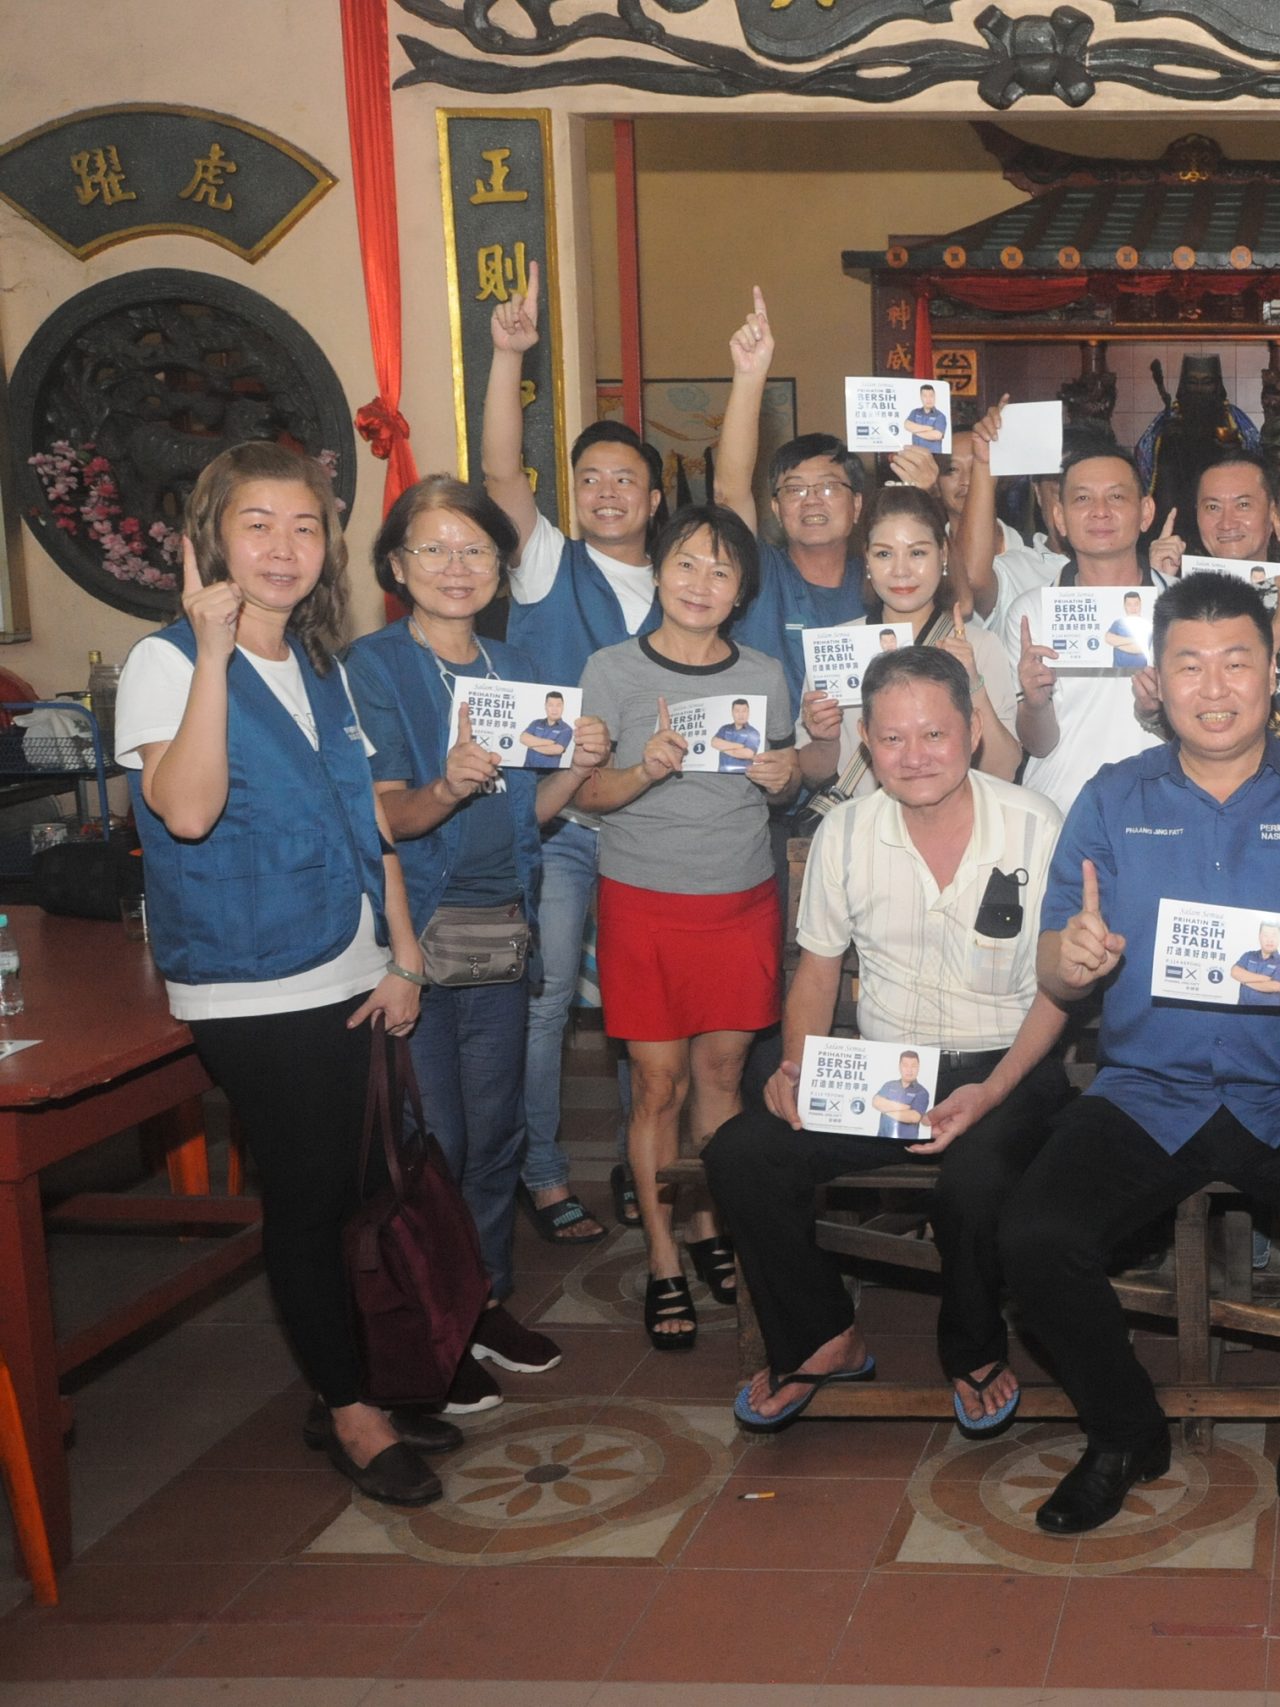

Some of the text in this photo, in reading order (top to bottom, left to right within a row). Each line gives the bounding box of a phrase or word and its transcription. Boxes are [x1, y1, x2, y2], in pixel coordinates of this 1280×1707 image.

[1055, 614, 1096, 622] STABIL
[814, 644, 854, 653] BERSIH
[815, 653, 854, 663] STABIL
[468, 697, 515, 709] BERSIH
[468, 707, 514, 719] STABIL
[673, 721, 704, 731] TABIL
[1174, 916, 1208, 925] PRIHATIN
[1173, 923, 1225, 938] BERSIH
[1172, 934, 1222, 950] STABIL
[818, 1058, 867, 1070] BERSIH
[816, 1068, 865, 1081] STABIL
